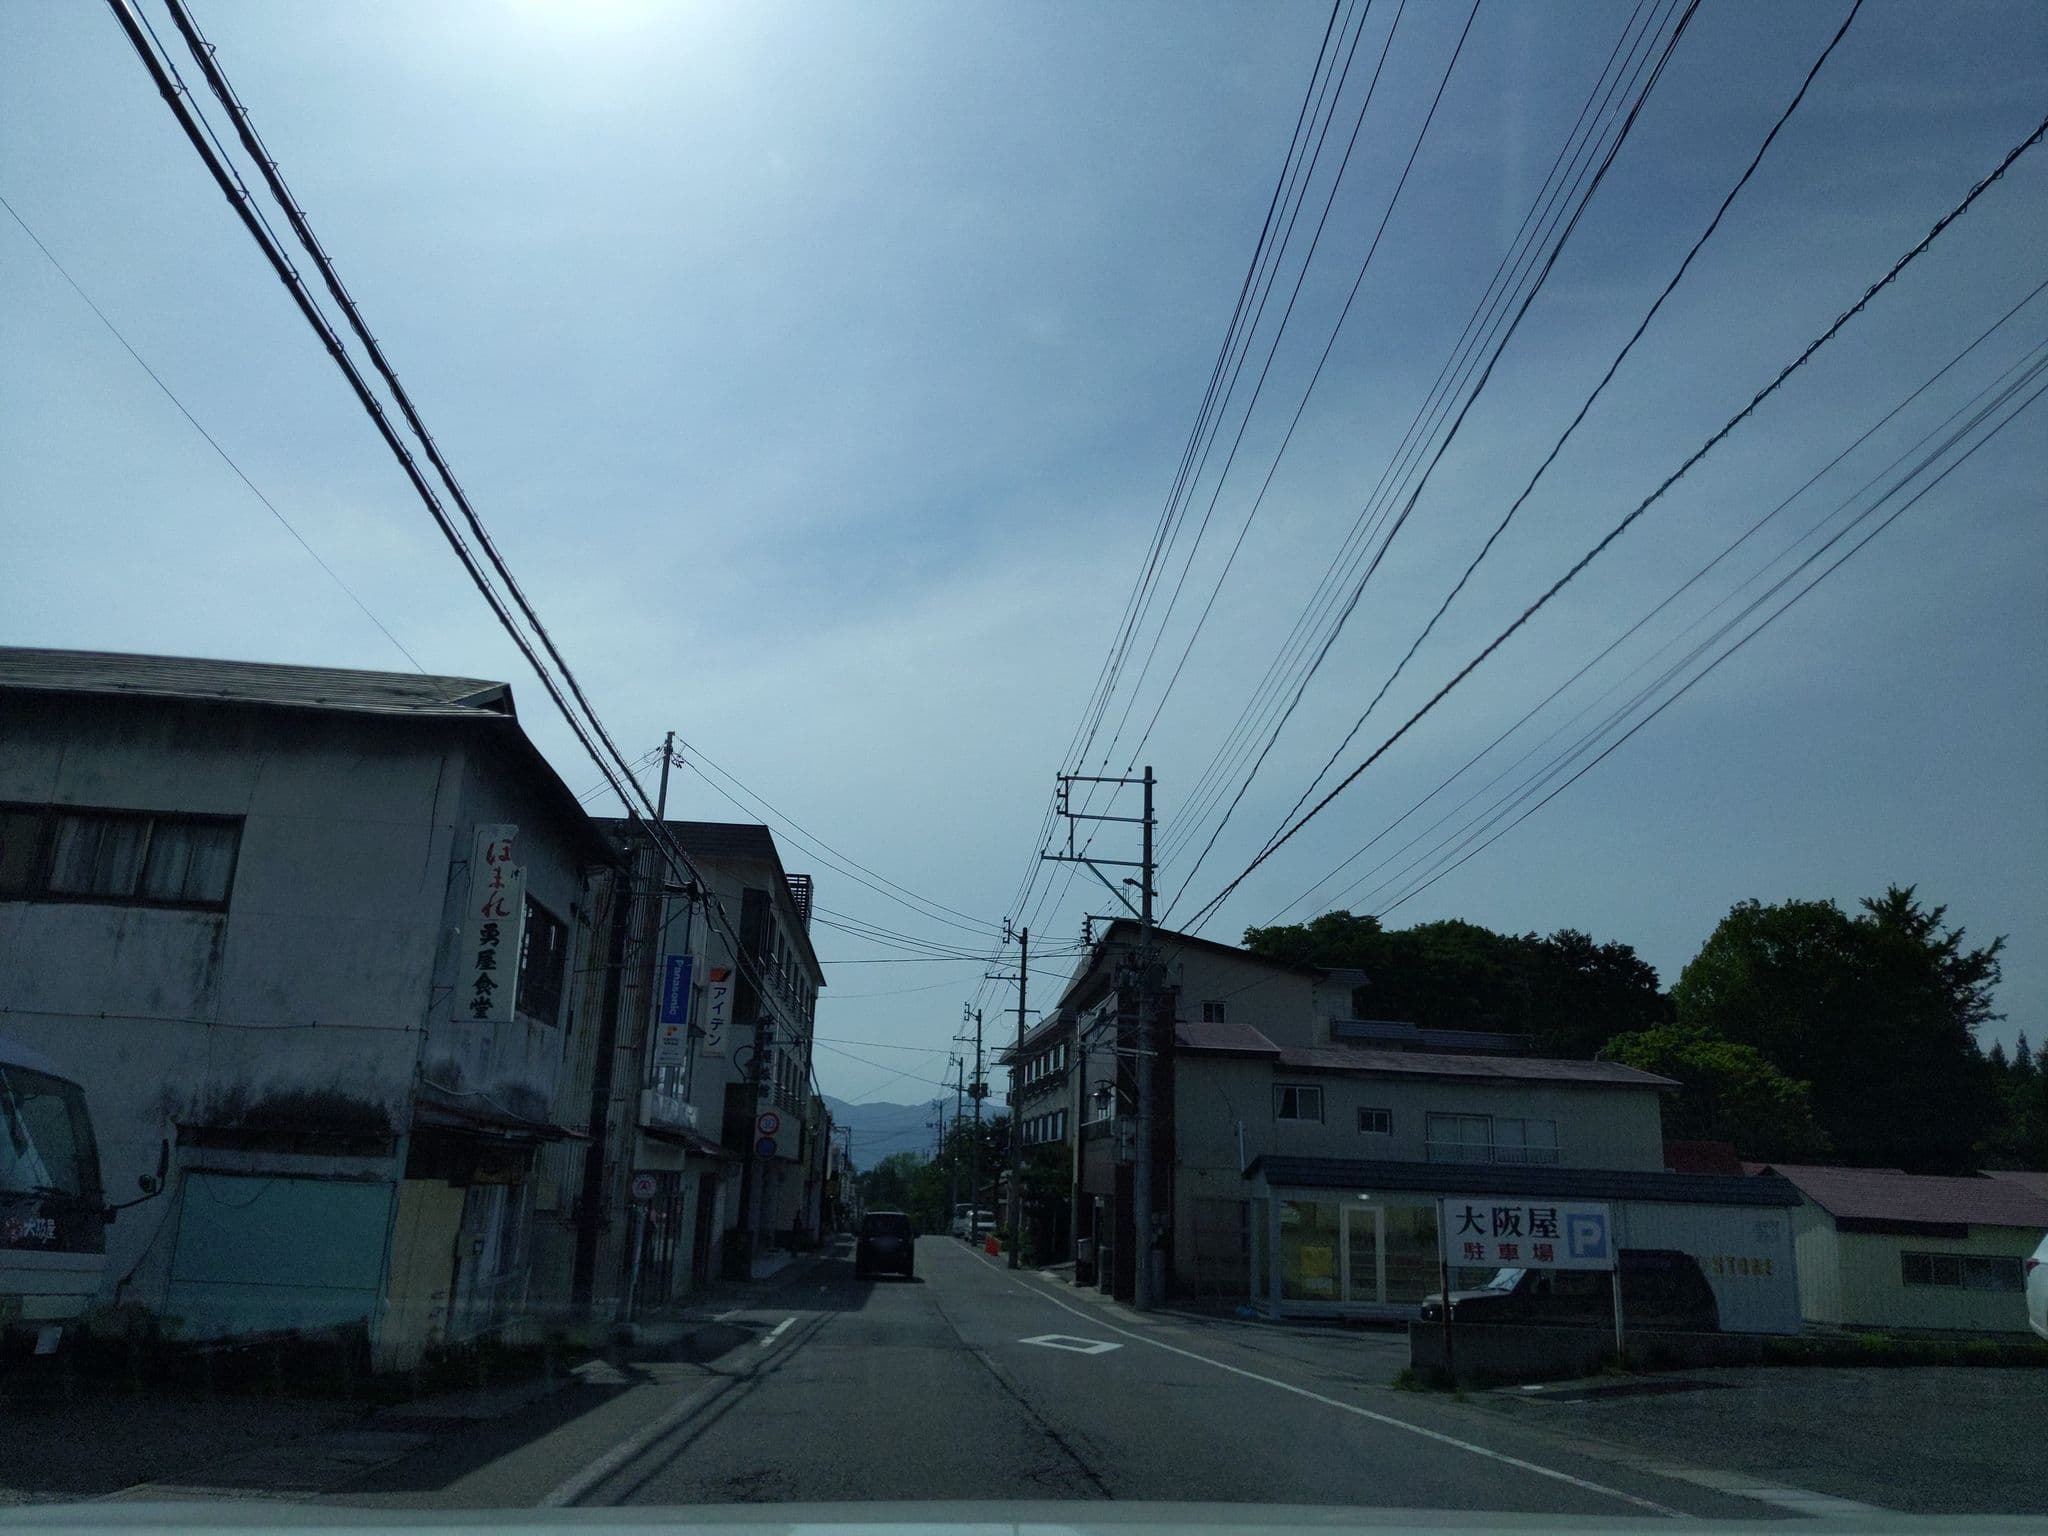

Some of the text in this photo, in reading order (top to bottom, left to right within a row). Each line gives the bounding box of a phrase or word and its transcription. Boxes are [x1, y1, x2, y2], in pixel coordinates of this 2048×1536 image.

[668, 959, 685, 1016] Panasonic
[1456, 1204, 1561, 1240] 大阪屋
[1571, 1218, 1602, 1255] P
[1463, 1242, 1555, 1263] 駐車場
